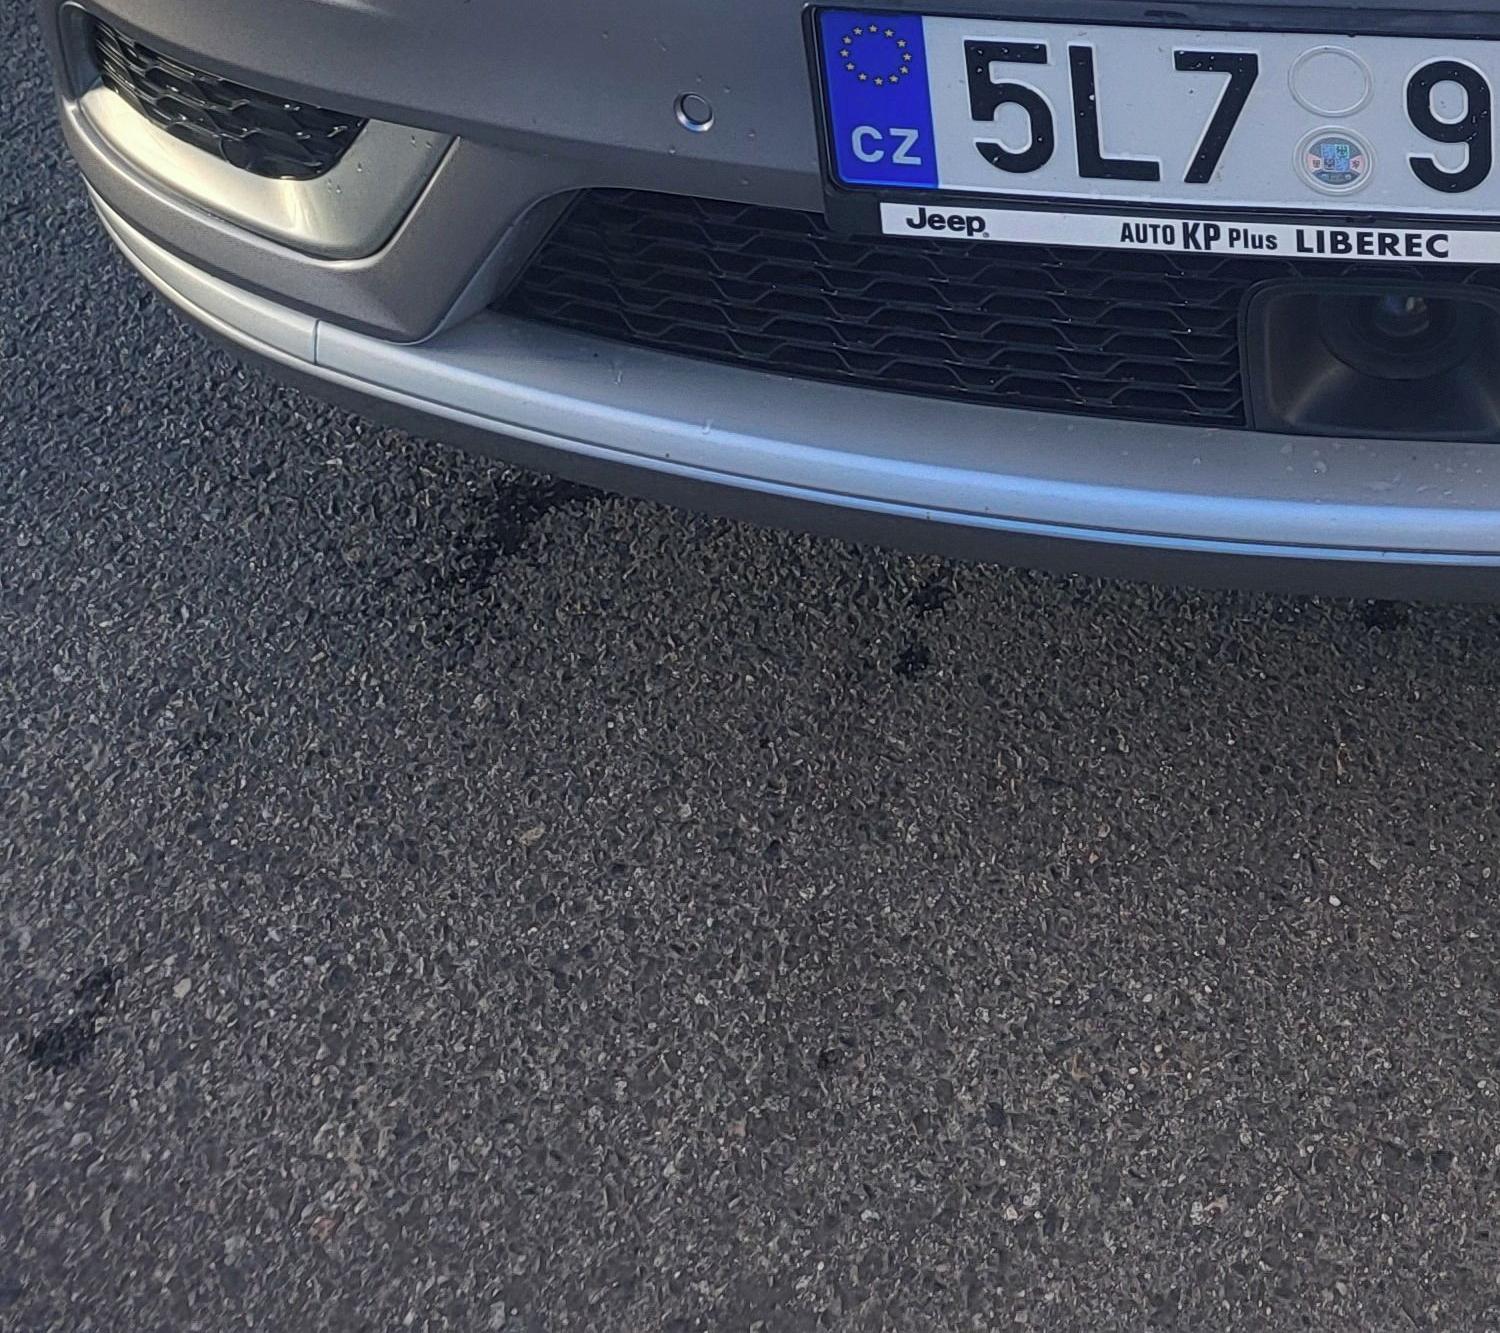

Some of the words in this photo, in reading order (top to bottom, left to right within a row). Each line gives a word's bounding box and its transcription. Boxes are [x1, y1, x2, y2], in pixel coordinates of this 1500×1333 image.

[963, 39, 1259, 184] 5L7
[851, 125, 922, 165] CZ
[906, 207, 986, 237] Jeep
[1120, 222, 1175, 245] AUTO
[1182, 222, 1221, 250] KP
[1228, 228, 1278, 250] Plus
[1296, 229, 1449, 258] LIBEREC
